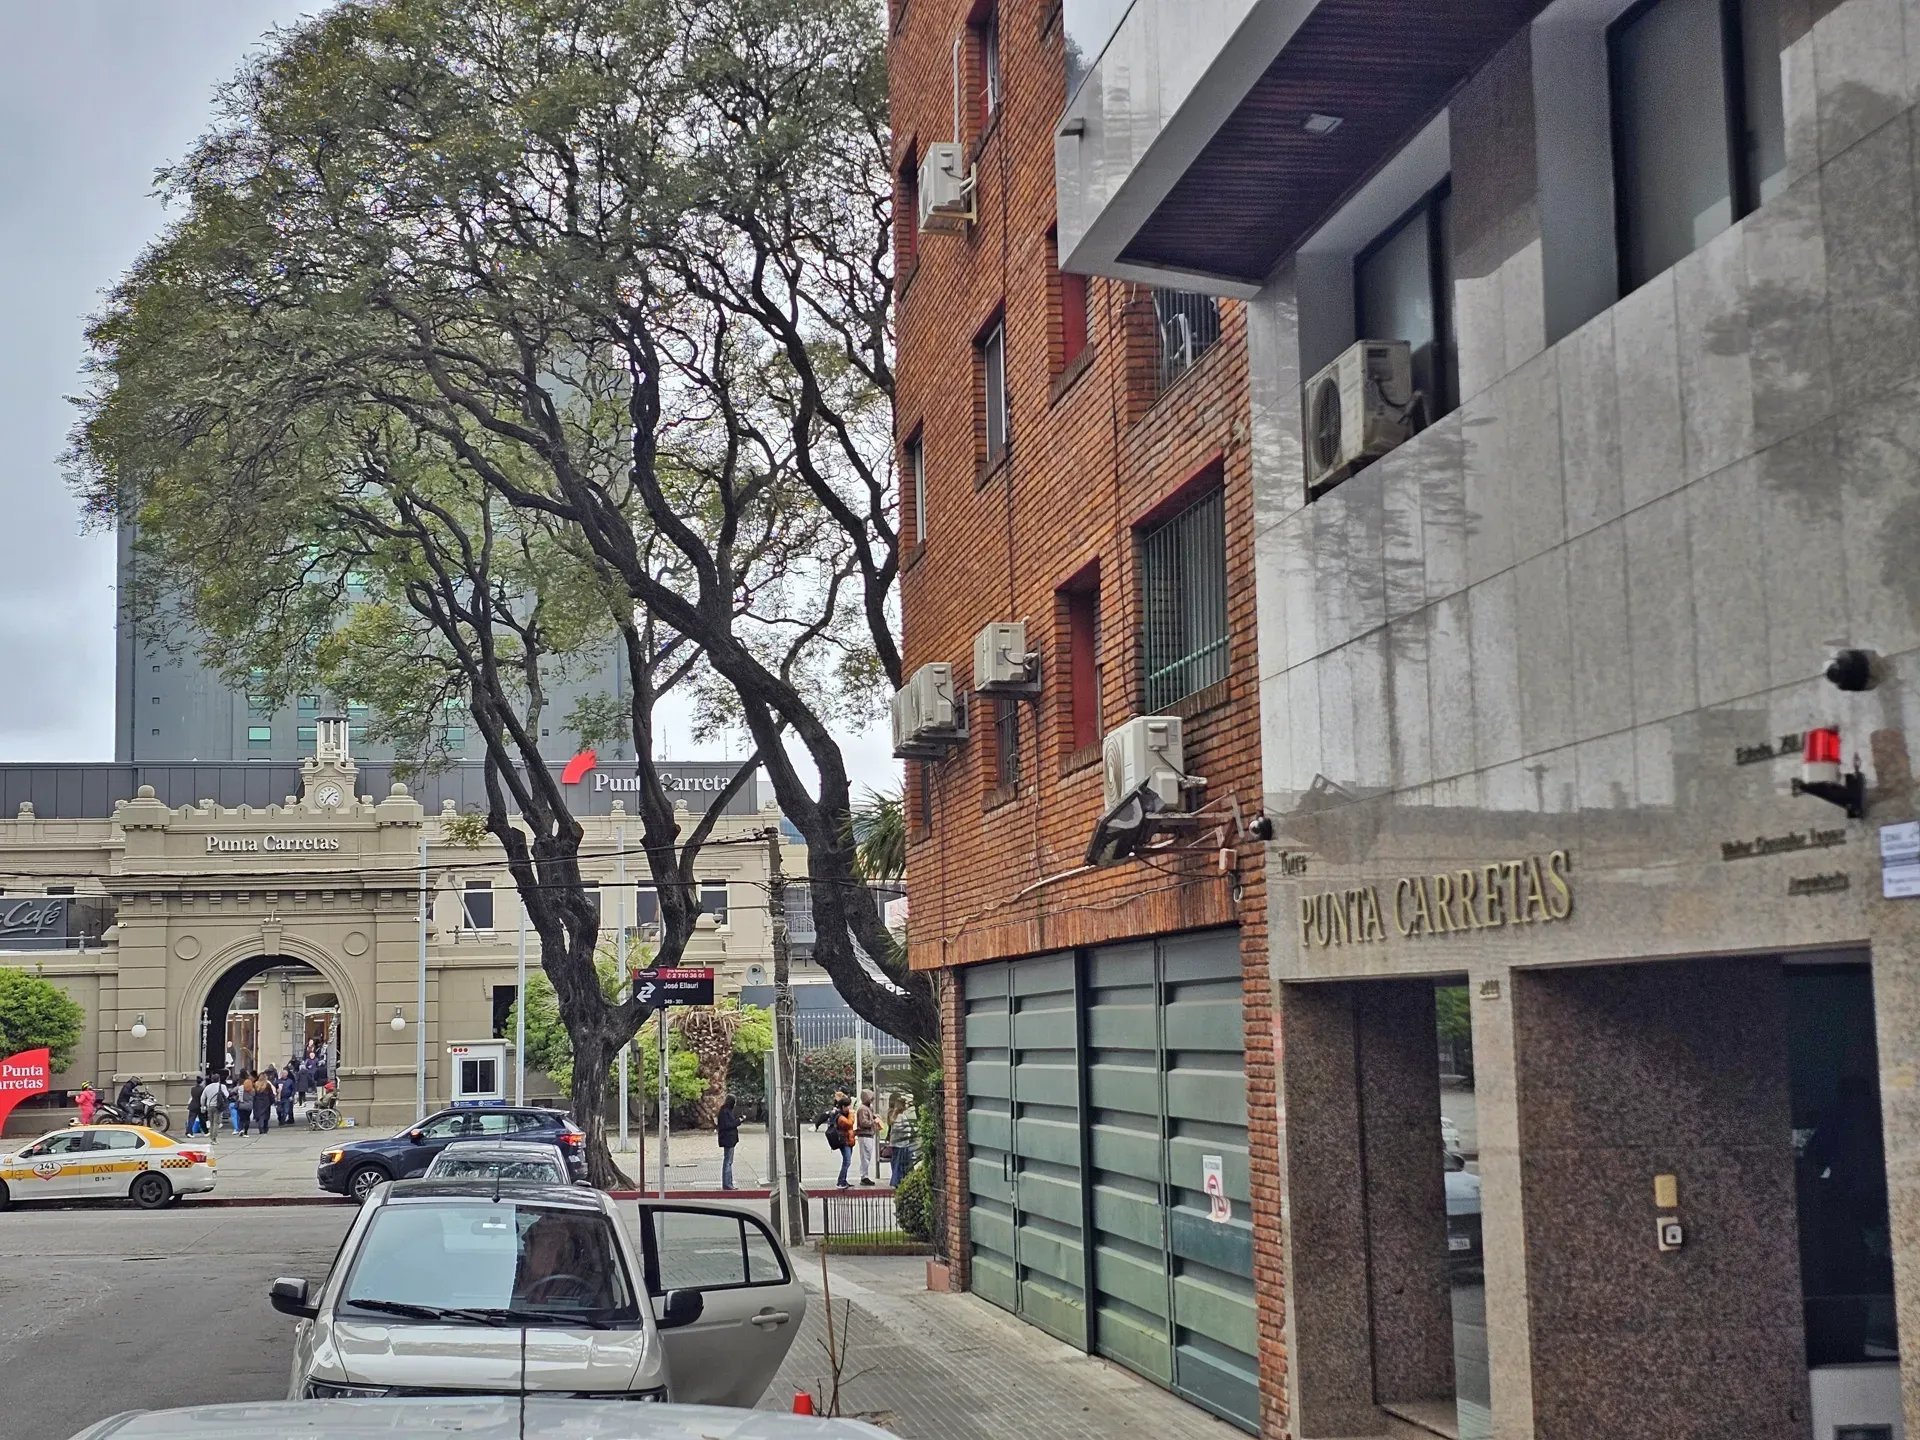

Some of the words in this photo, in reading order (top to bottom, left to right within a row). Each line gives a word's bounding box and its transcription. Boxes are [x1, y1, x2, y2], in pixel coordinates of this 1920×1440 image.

[594, 773, 641, 792] Punt
[206, 835, 258, 851] Punta
[263, 834, 340, 850] Carretas
[1299, 885, 1387, 947] PUNTA
[1394, 849, 1573, 937] CARRETAS
[2, 1064, 44, 1077] Punta
[39, 1162, 55, 1171] 141
[92, 1164, 114, 1173] TAXI
